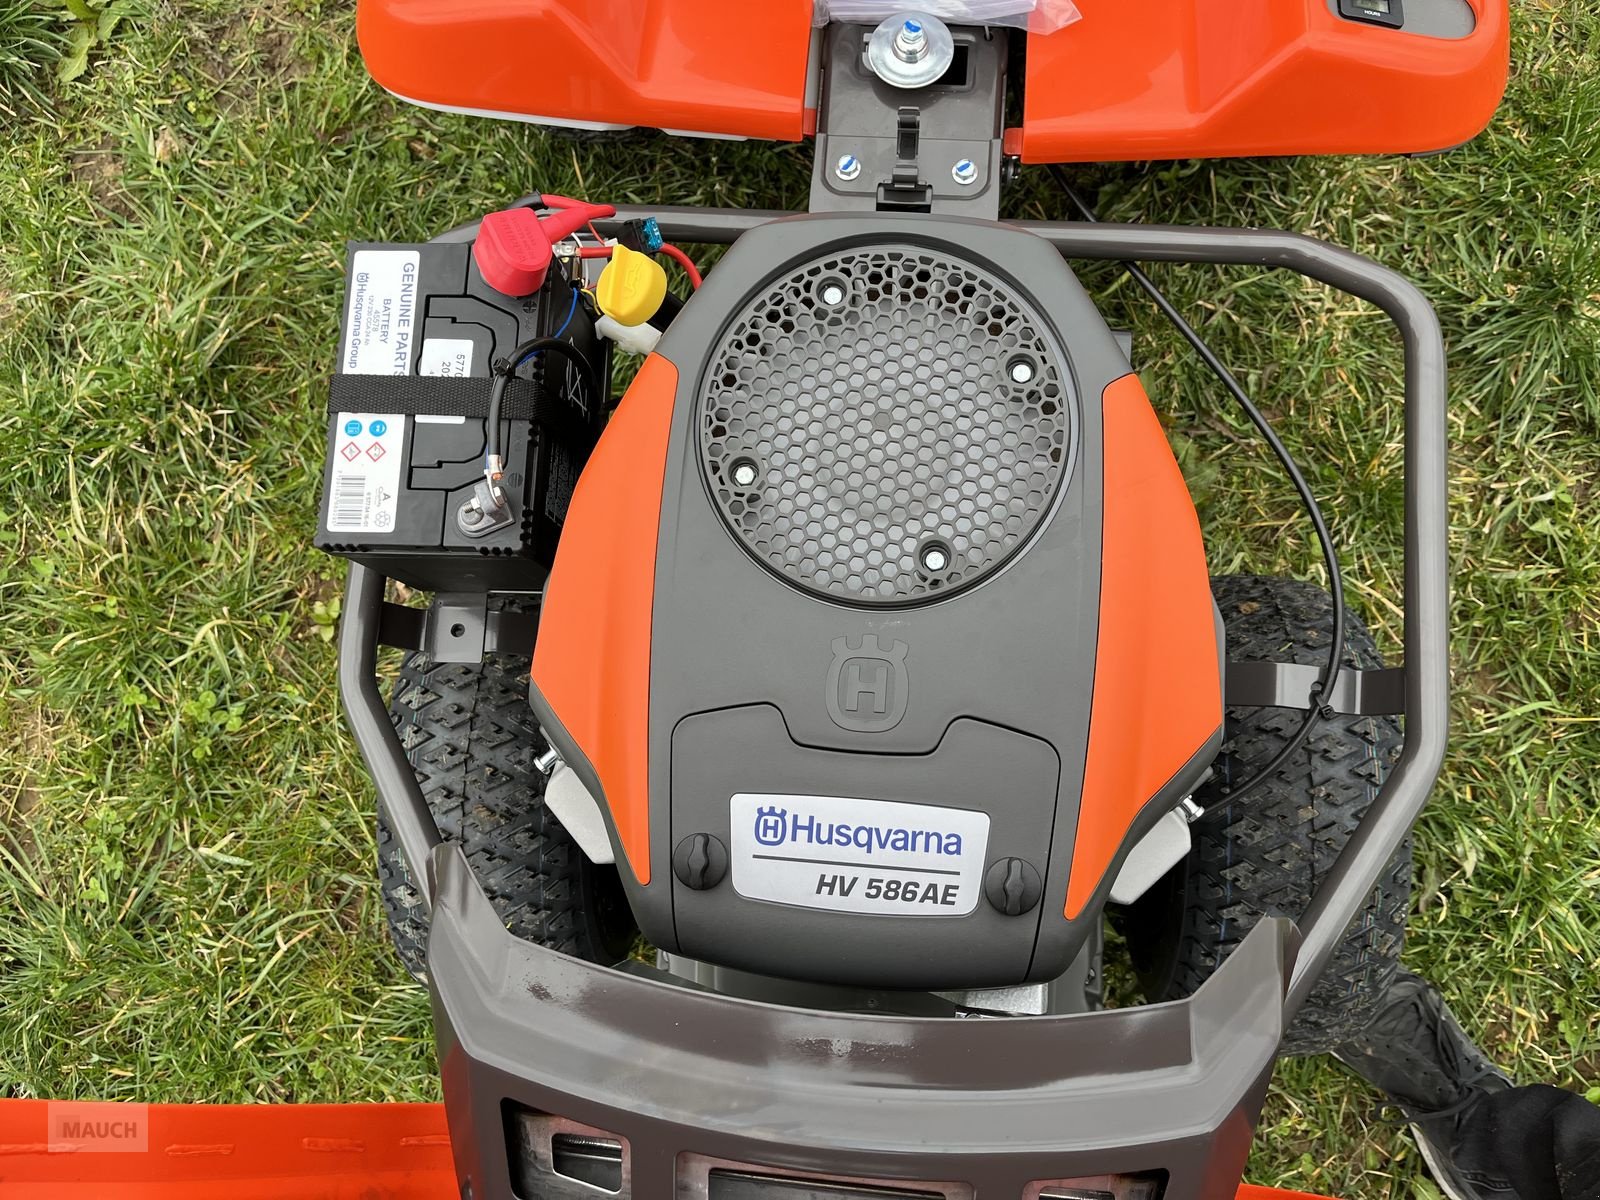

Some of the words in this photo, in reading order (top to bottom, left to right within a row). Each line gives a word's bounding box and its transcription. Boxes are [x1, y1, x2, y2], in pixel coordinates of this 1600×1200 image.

[1364, 9, 1381, 17] HOURS
[352, 283, 367, 337] Husqvarna
[397, 262, 415, 328] GENUINE
[372, 309, 381, 332] 45578
[379, 298, 392, 344] BATTERY
[349, 338, 361, 369] Group
[791, 814, 962, 855] Husqvarna
[815, 874, 859, 897] HV
[865, 878, 960, 906] 586AE
